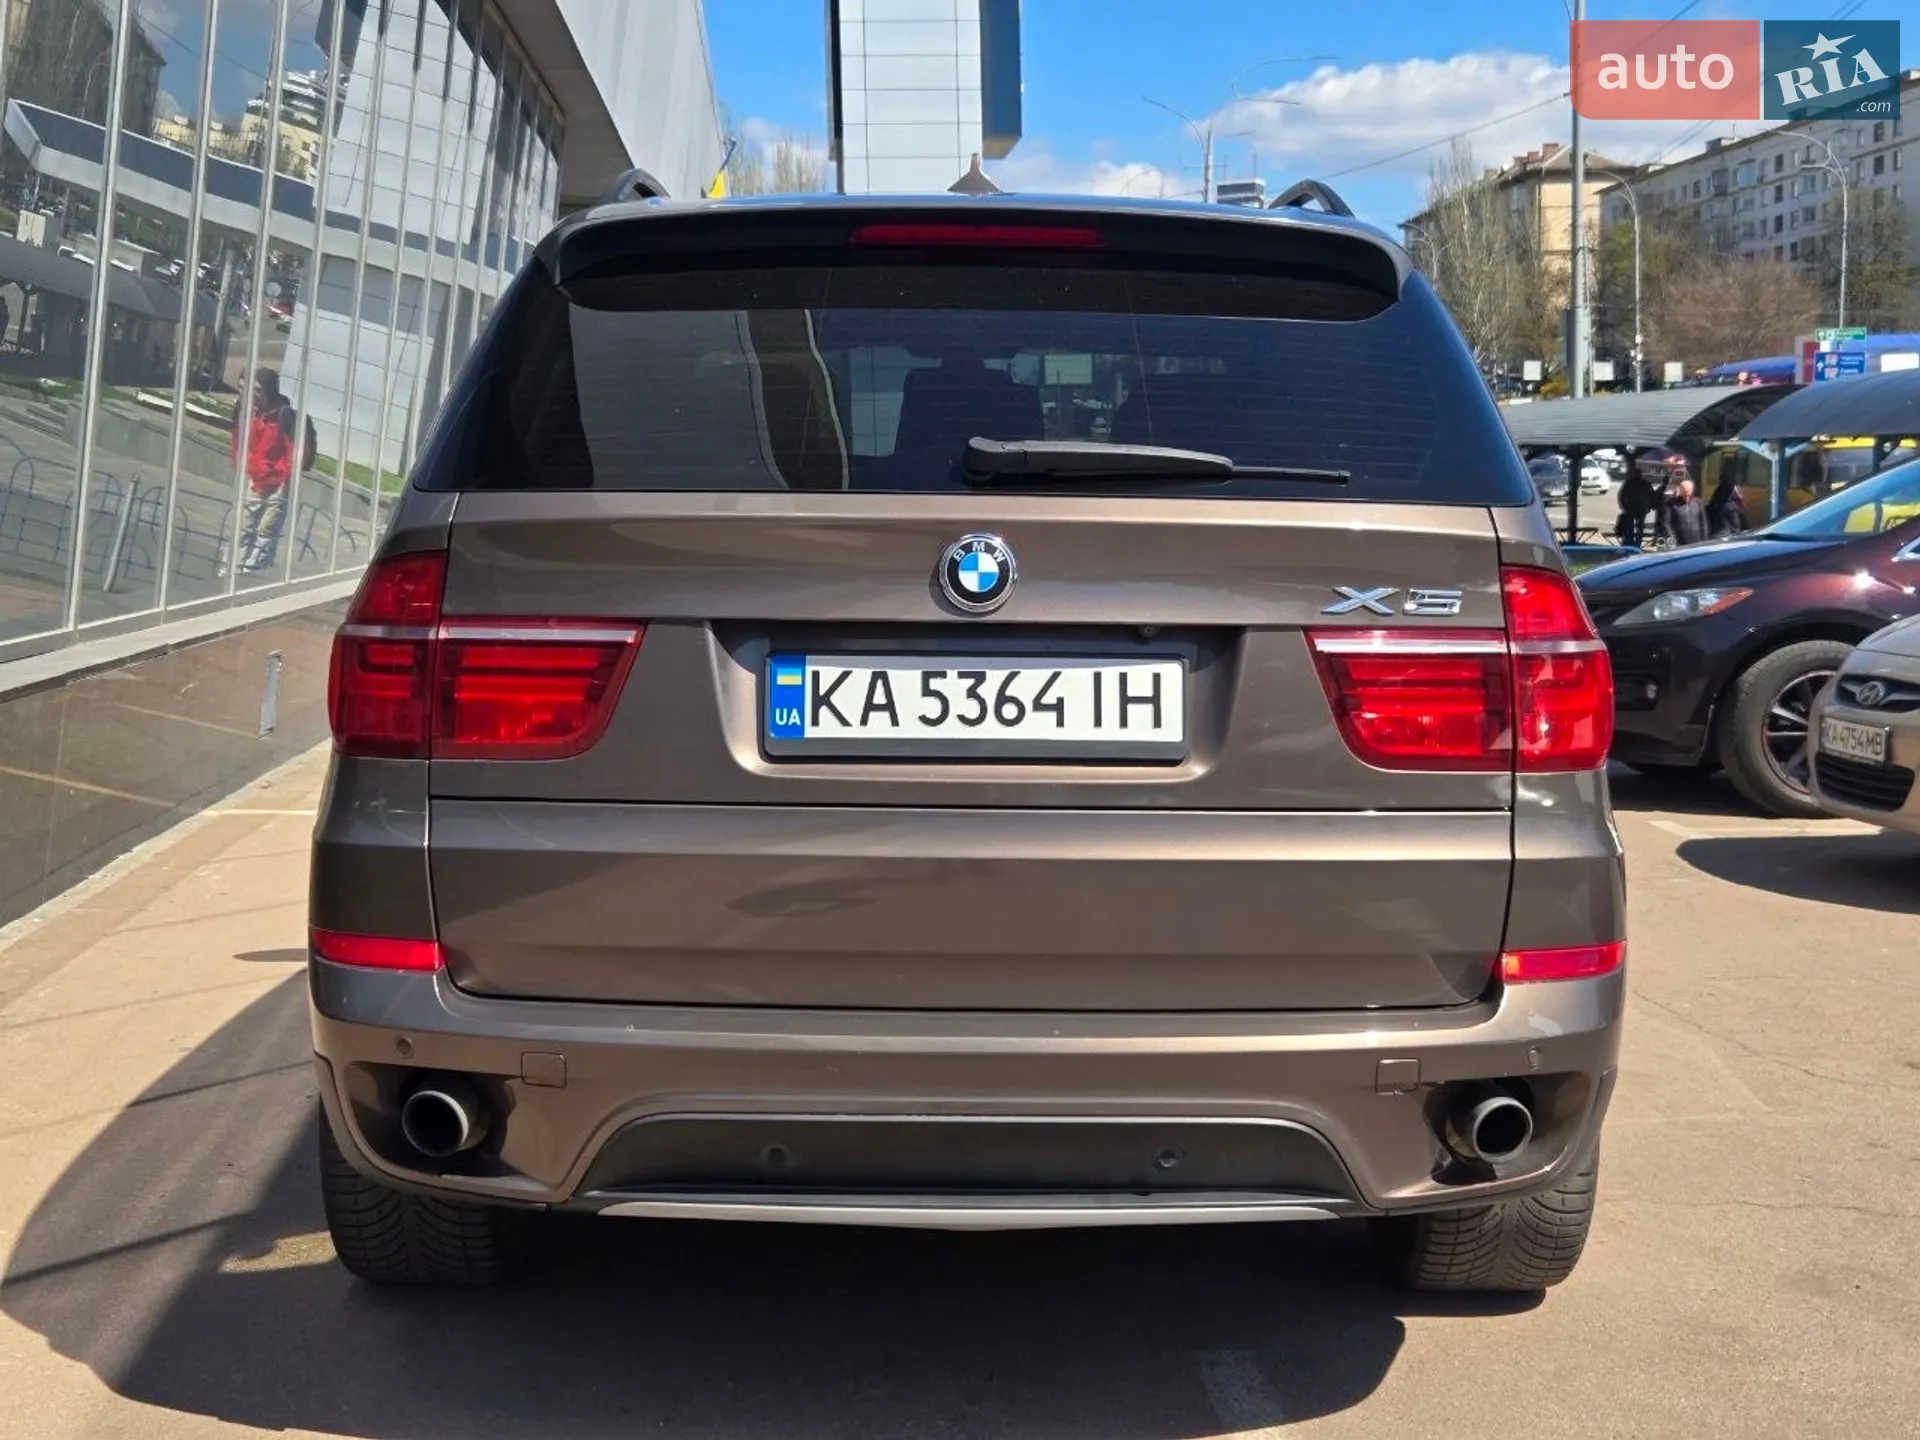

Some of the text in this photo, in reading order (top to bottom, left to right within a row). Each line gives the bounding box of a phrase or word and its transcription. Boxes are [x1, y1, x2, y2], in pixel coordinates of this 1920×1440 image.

[953, 541, 1007, 563] BMW
[1320, 586, 1463, 616] X5
[775, 669, 1163, 729] UA KA 5364 IH
